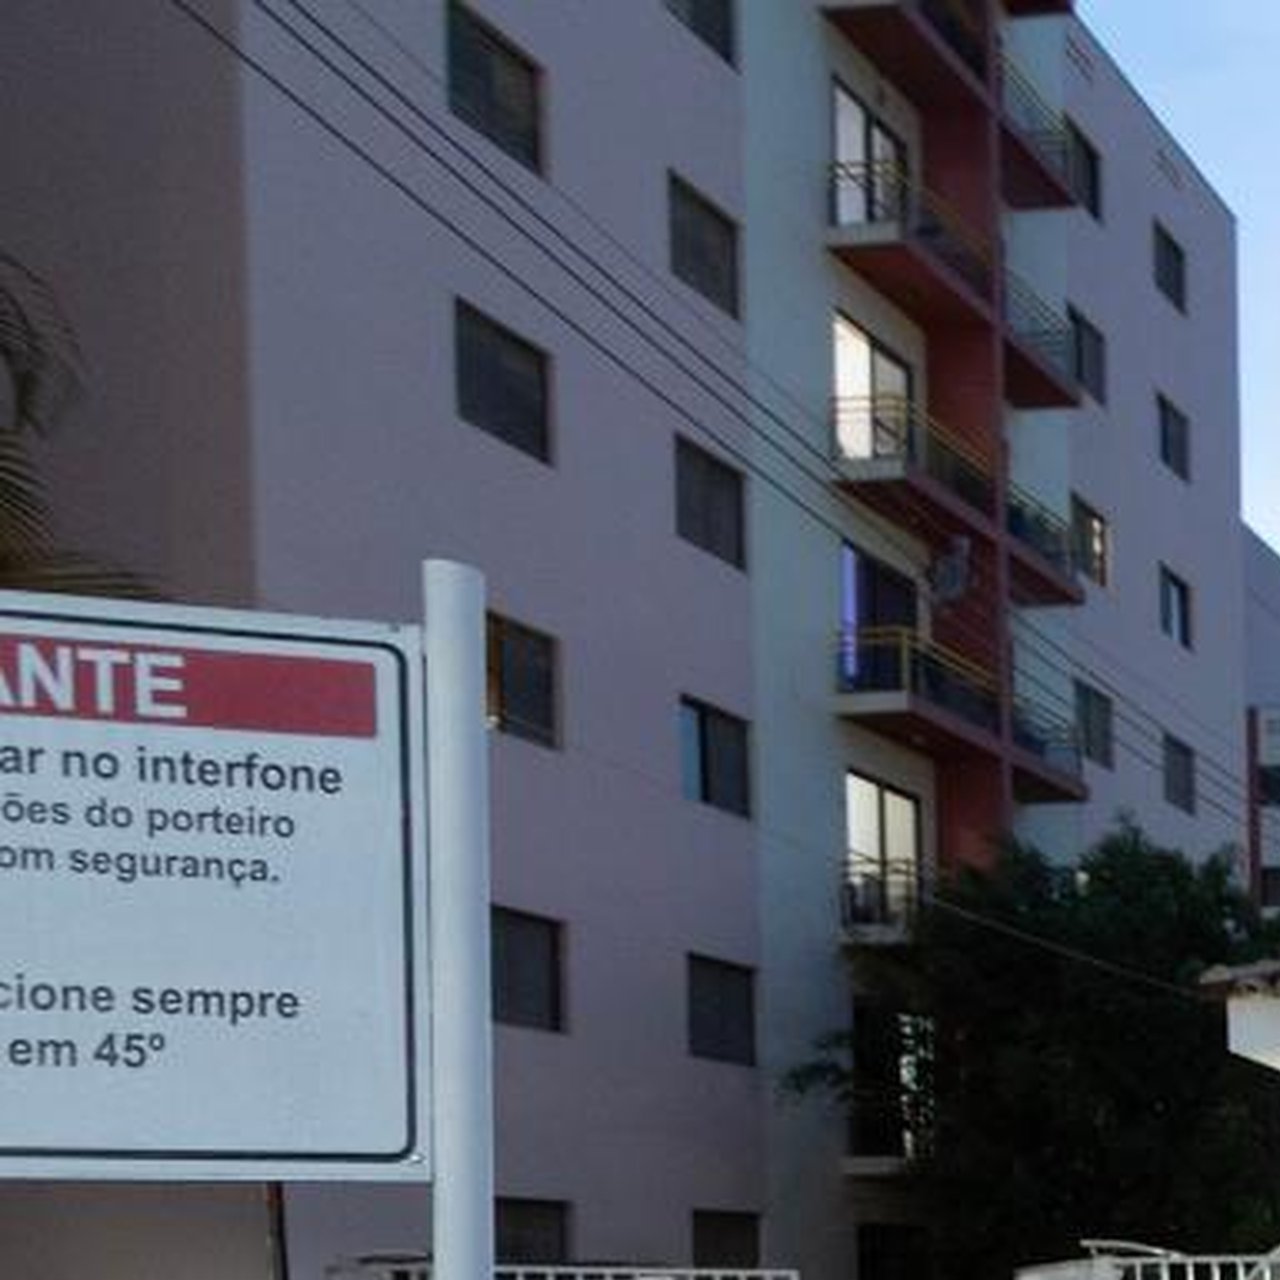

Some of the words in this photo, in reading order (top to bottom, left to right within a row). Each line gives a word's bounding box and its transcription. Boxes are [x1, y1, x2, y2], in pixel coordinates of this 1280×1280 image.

[0, 746, 45, 775] ar
[62, 751, 119, 779] no
[136, 746, 343, 794] interfone
[2, 792, 70, 825] ões
[84, 797, 133, 828] do
[147, 805, 296, 838] porteiro
[0, 846, 54, 870] om
[69, 849, 281, 886] segurança.
[131, 987, 301, 1024] sempre
[8, 1038, 78, 1068] em
